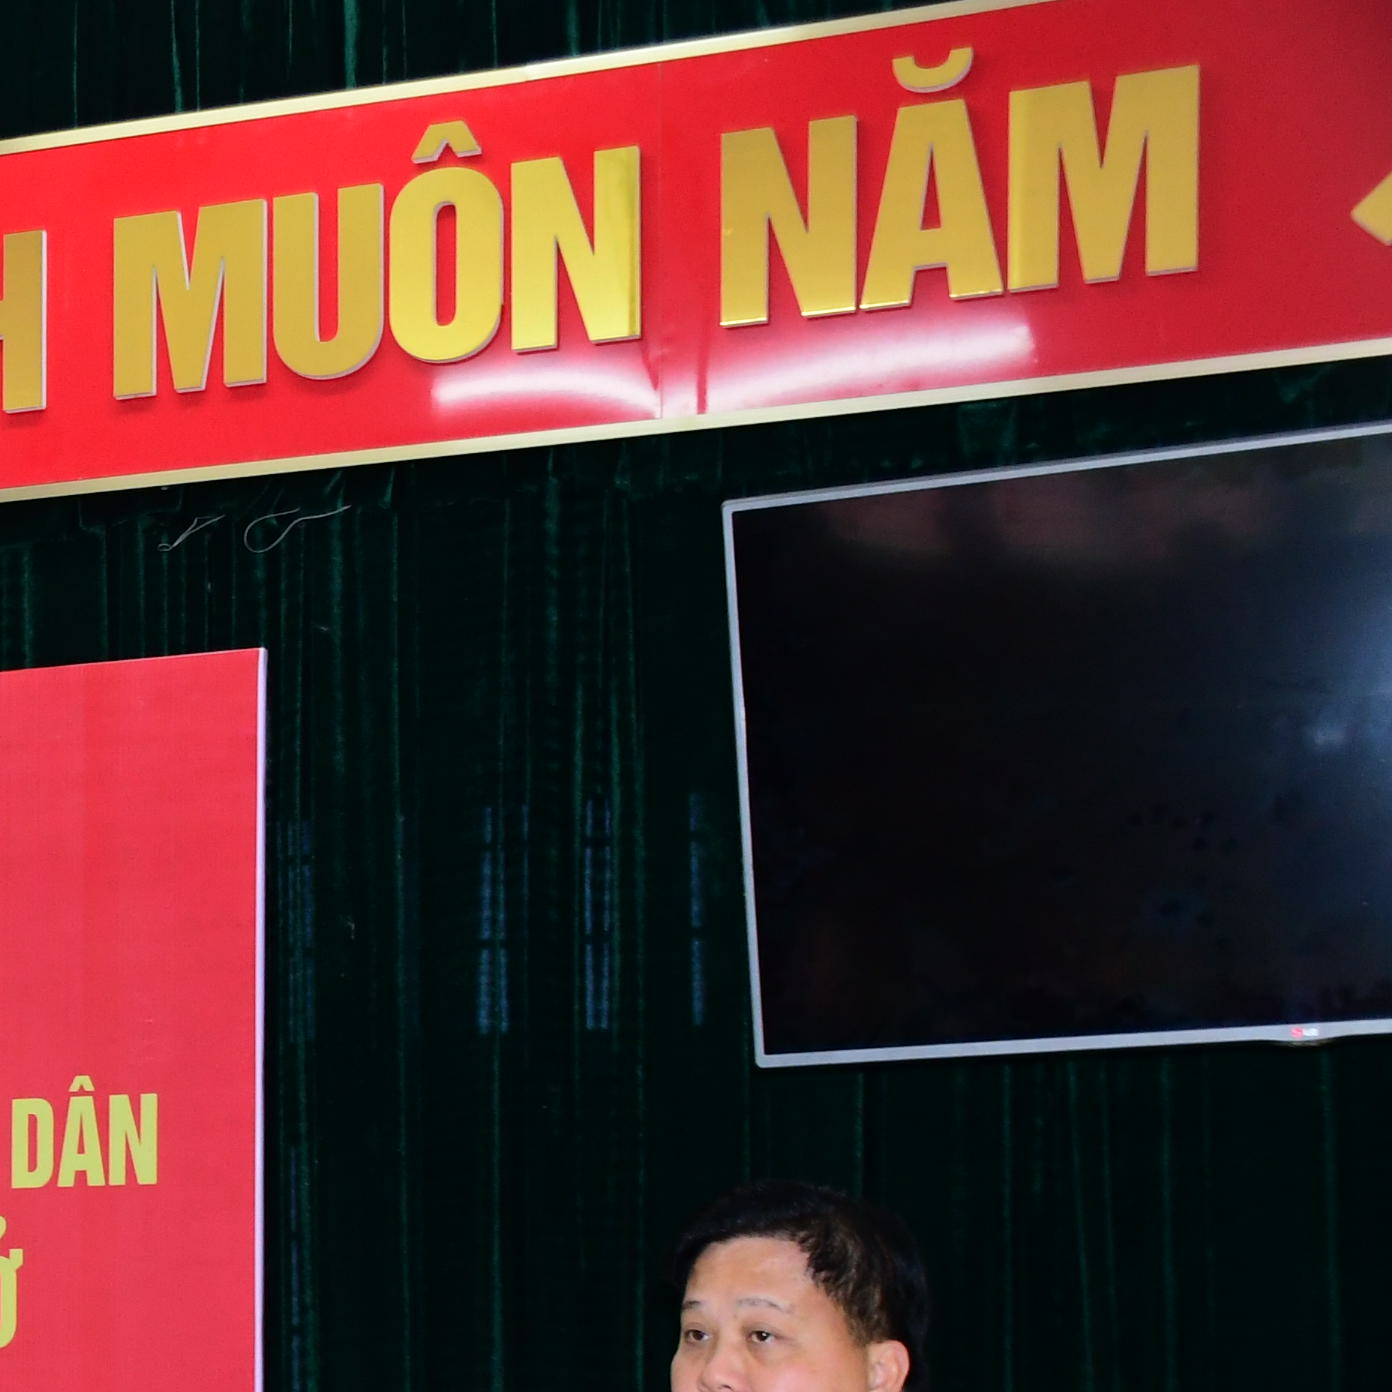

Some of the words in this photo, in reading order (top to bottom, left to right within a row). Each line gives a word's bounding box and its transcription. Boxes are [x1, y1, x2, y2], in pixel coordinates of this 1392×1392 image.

[112, 118, 644, 403] MUÔN
[718, 46, 1202, 329] NĂM
[9, 1073, 160, 1191] DÂN
